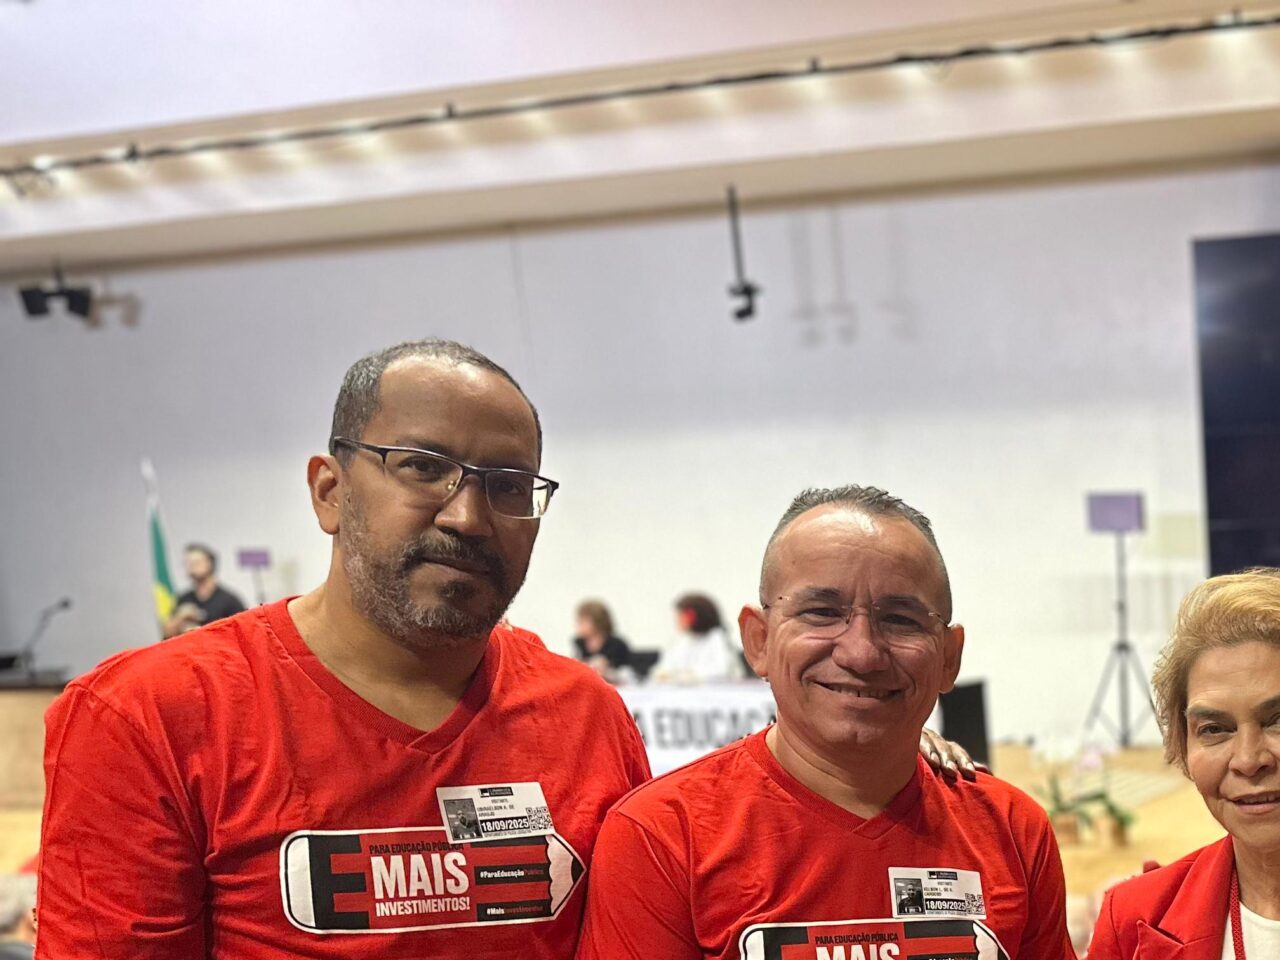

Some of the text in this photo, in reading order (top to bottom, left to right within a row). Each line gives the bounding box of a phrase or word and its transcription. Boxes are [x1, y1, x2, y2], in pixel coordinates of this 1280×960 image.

[482, 819, 529, 831] 18/09/2025
[370, 844, 390, 854] PARA
[392, 841, 430, 854] EDUCAÇÃO
[370, 852, 469, 899] MAIS
[376, 897, 470, 917] INVESTIMENTOS!
[926, 901, 966, 910] 18/09/2025
[815, 932, 898, 944] PARA EDUCAÇÃO PÚBLICA
